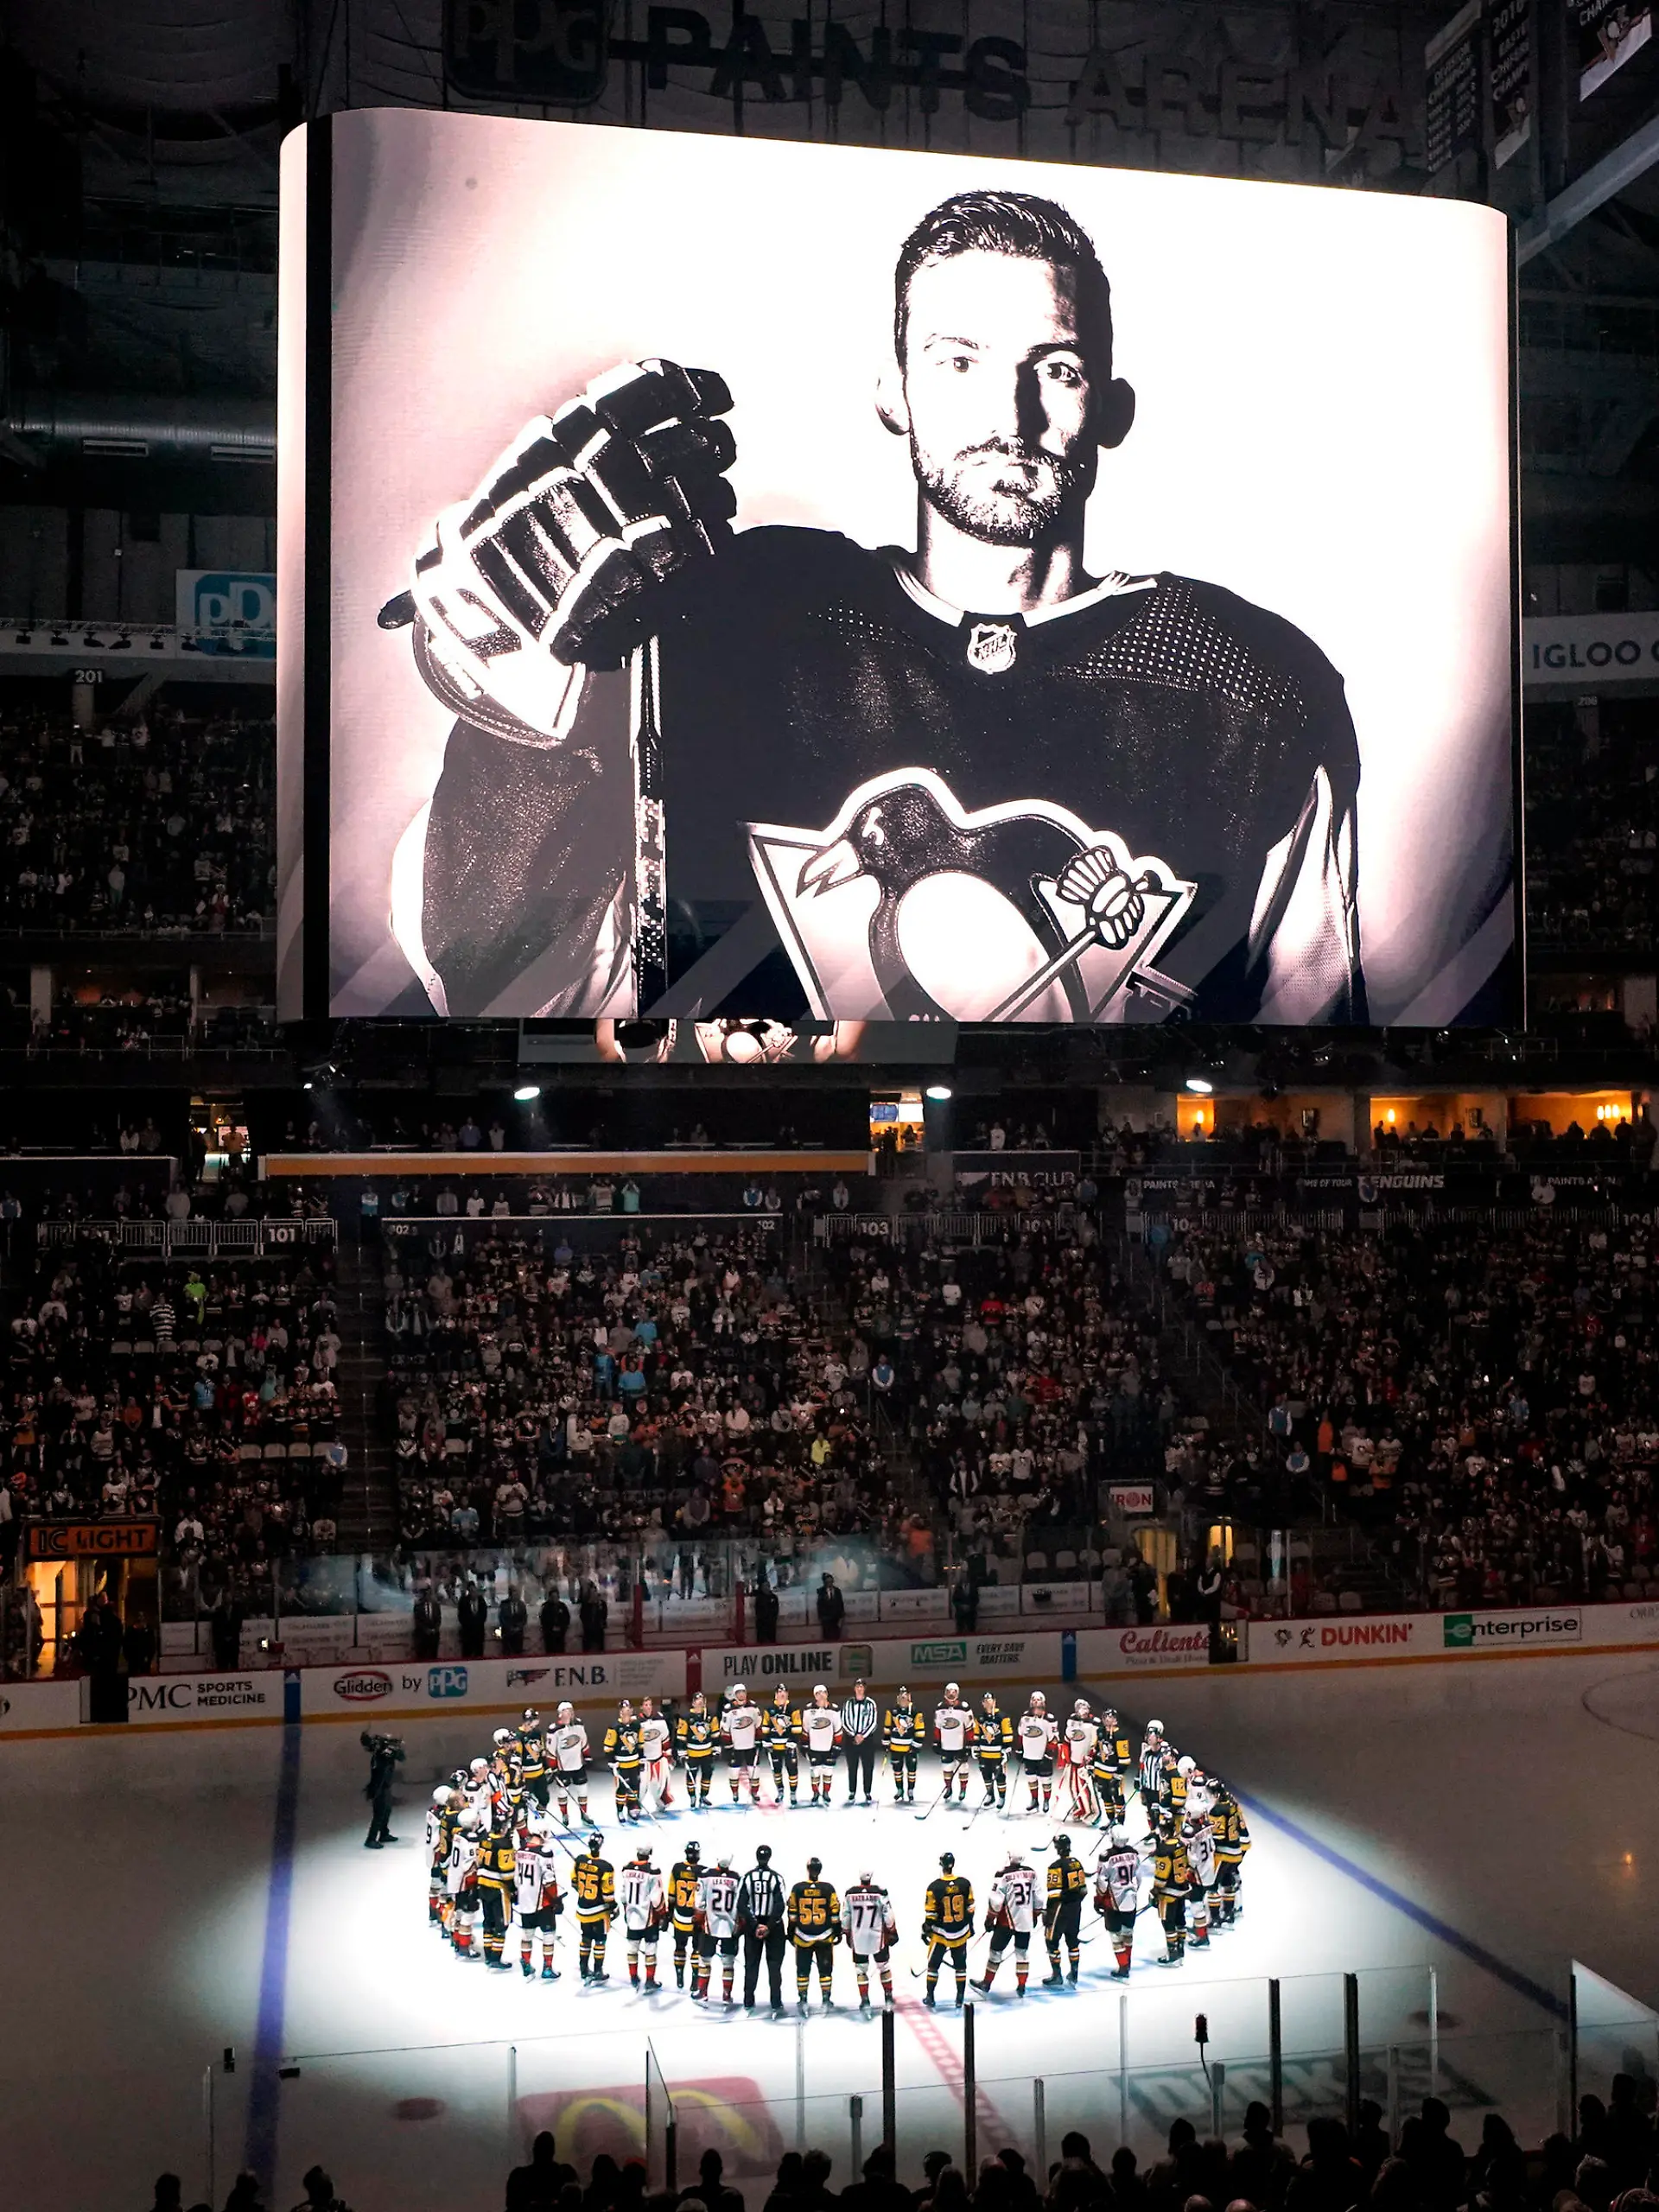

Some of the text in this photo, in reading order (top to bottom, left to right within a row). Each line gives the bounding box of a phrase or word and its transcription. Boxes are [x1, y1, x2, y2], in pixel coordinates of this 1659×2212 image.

[647, 7, 1031, 121] PAINTS
[976, 634, 1008, 659] NHL
[1533, 640, 1641, 669] IGLOO
[75, 670, 103, 684] 201
[268, 1228, 296, 1243] 101
[861, 1222, 889, 1236] 103
[38, 1529, 147, 1553] IC LIGHT
[1320, 1624, 1413, 1647] DUNKIN'
[1452, 1616, 1579, 1641] enterprise
[723, 1651, 832, 1676] PLAY ONLINE
[915, 1644, 963, 1662] MSA
[197, 1681, 253, 1694] SPORTS
[334, 1669, 467, 1695] Glidden by PPG
[197, 1693, 265, 1707] MEDICINE
[578, 1871, 599, 1900] 65
[628, 1881, 640, 1905] 11
[711, 1889, 734, 1912] 20
[798, 1897, 827, 1926] 55
[942, 1894, 964, 1923] 19
[853, 1904, 883, 1929] 77
